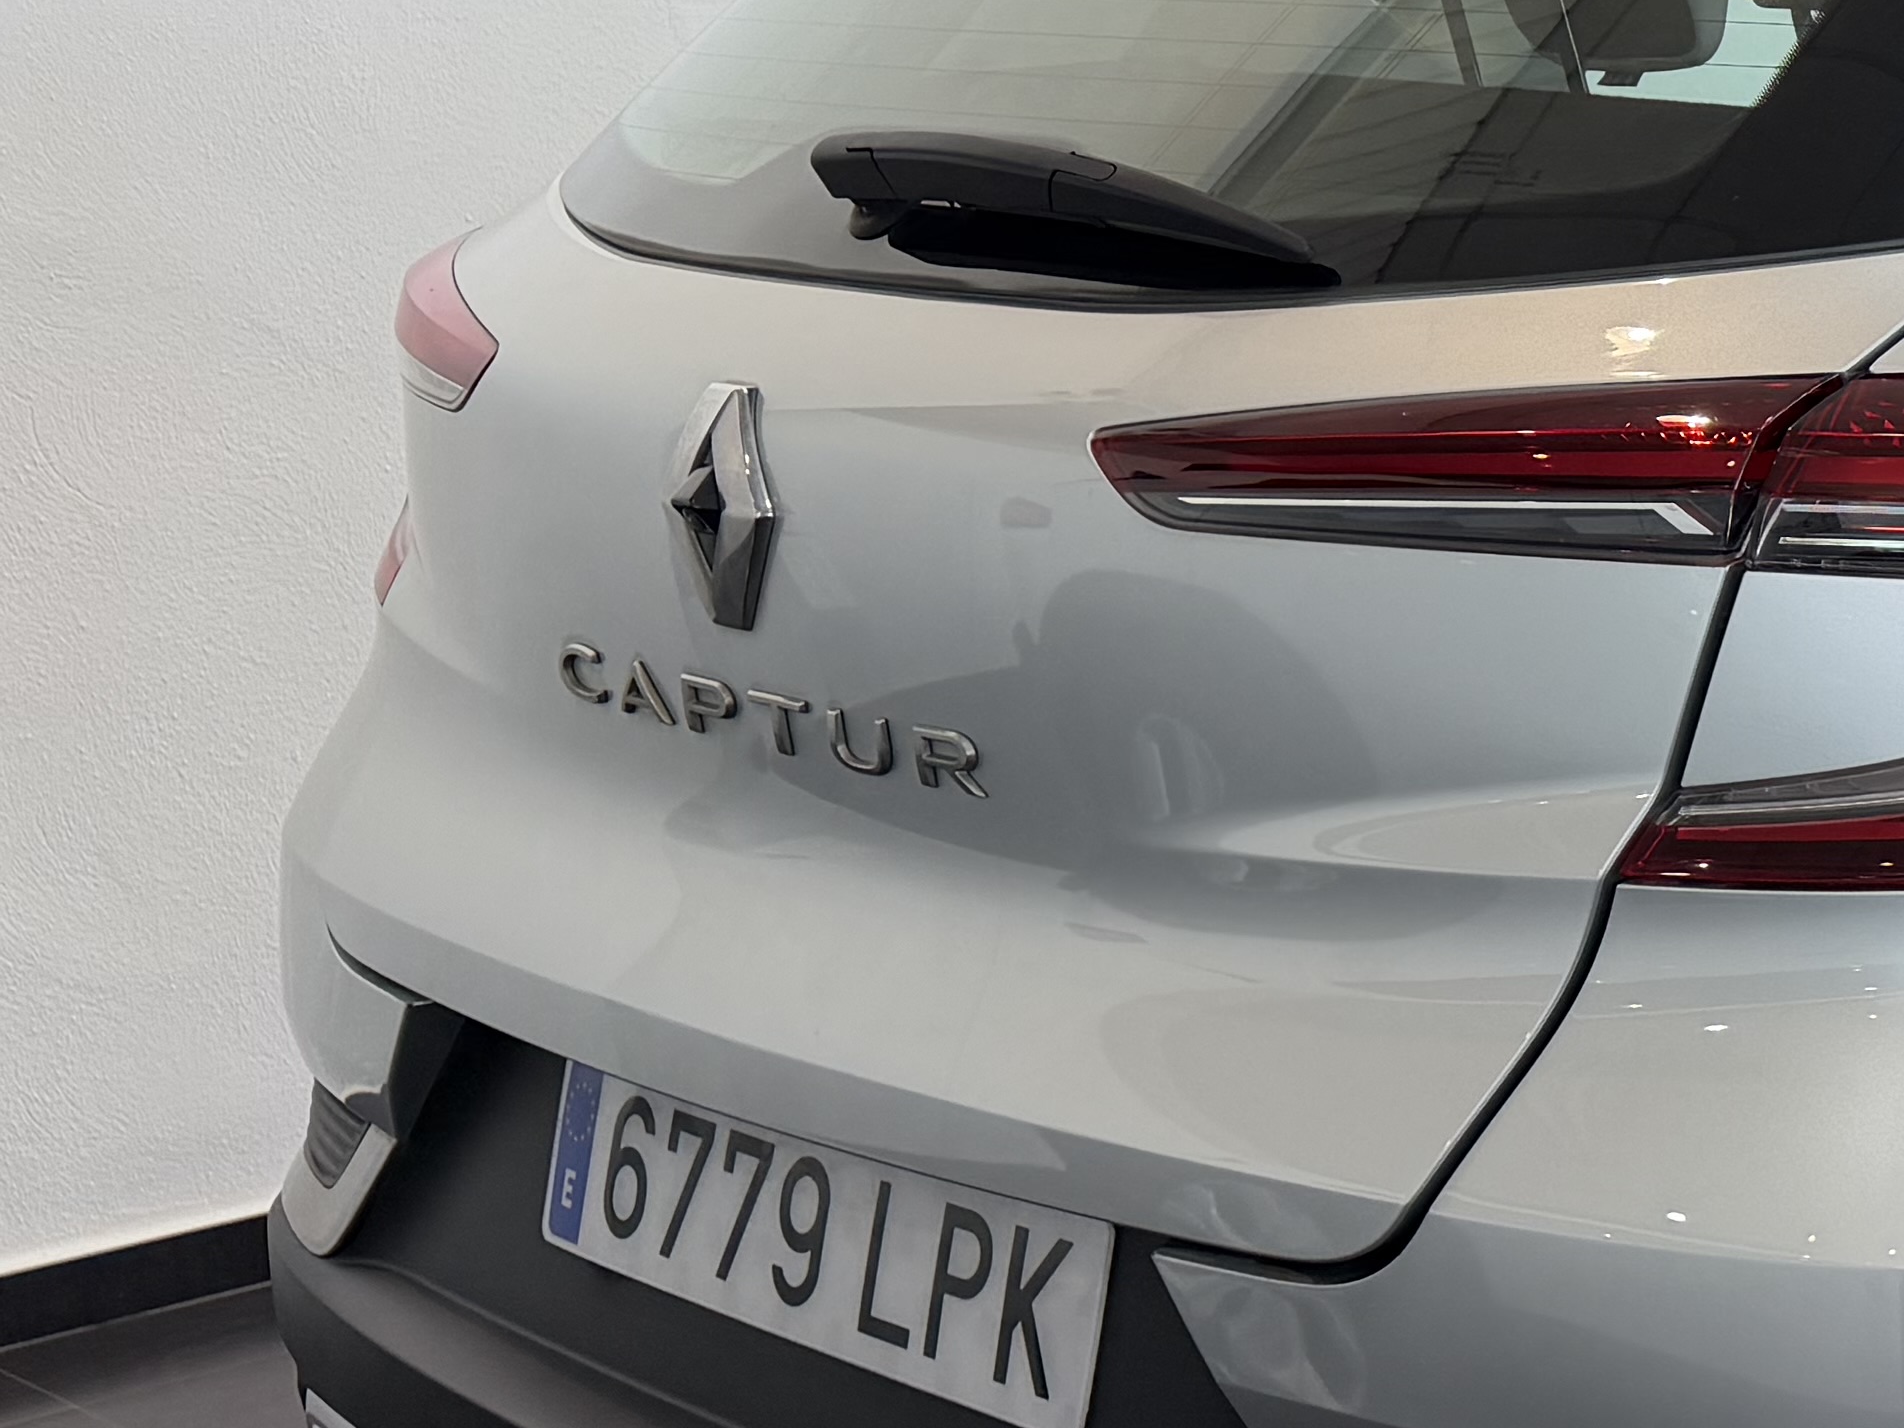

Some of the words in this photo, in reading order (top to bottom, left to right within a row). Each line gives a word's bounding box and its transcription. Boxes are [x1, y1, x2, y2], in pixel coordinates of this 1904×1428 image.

[558, 642, 990, 799] CAPTUR
[561, 1167, 577, 1209] E
[603, 1094, 833, 1308] 6779
[857, 1179, 1075, 1402] LPK
